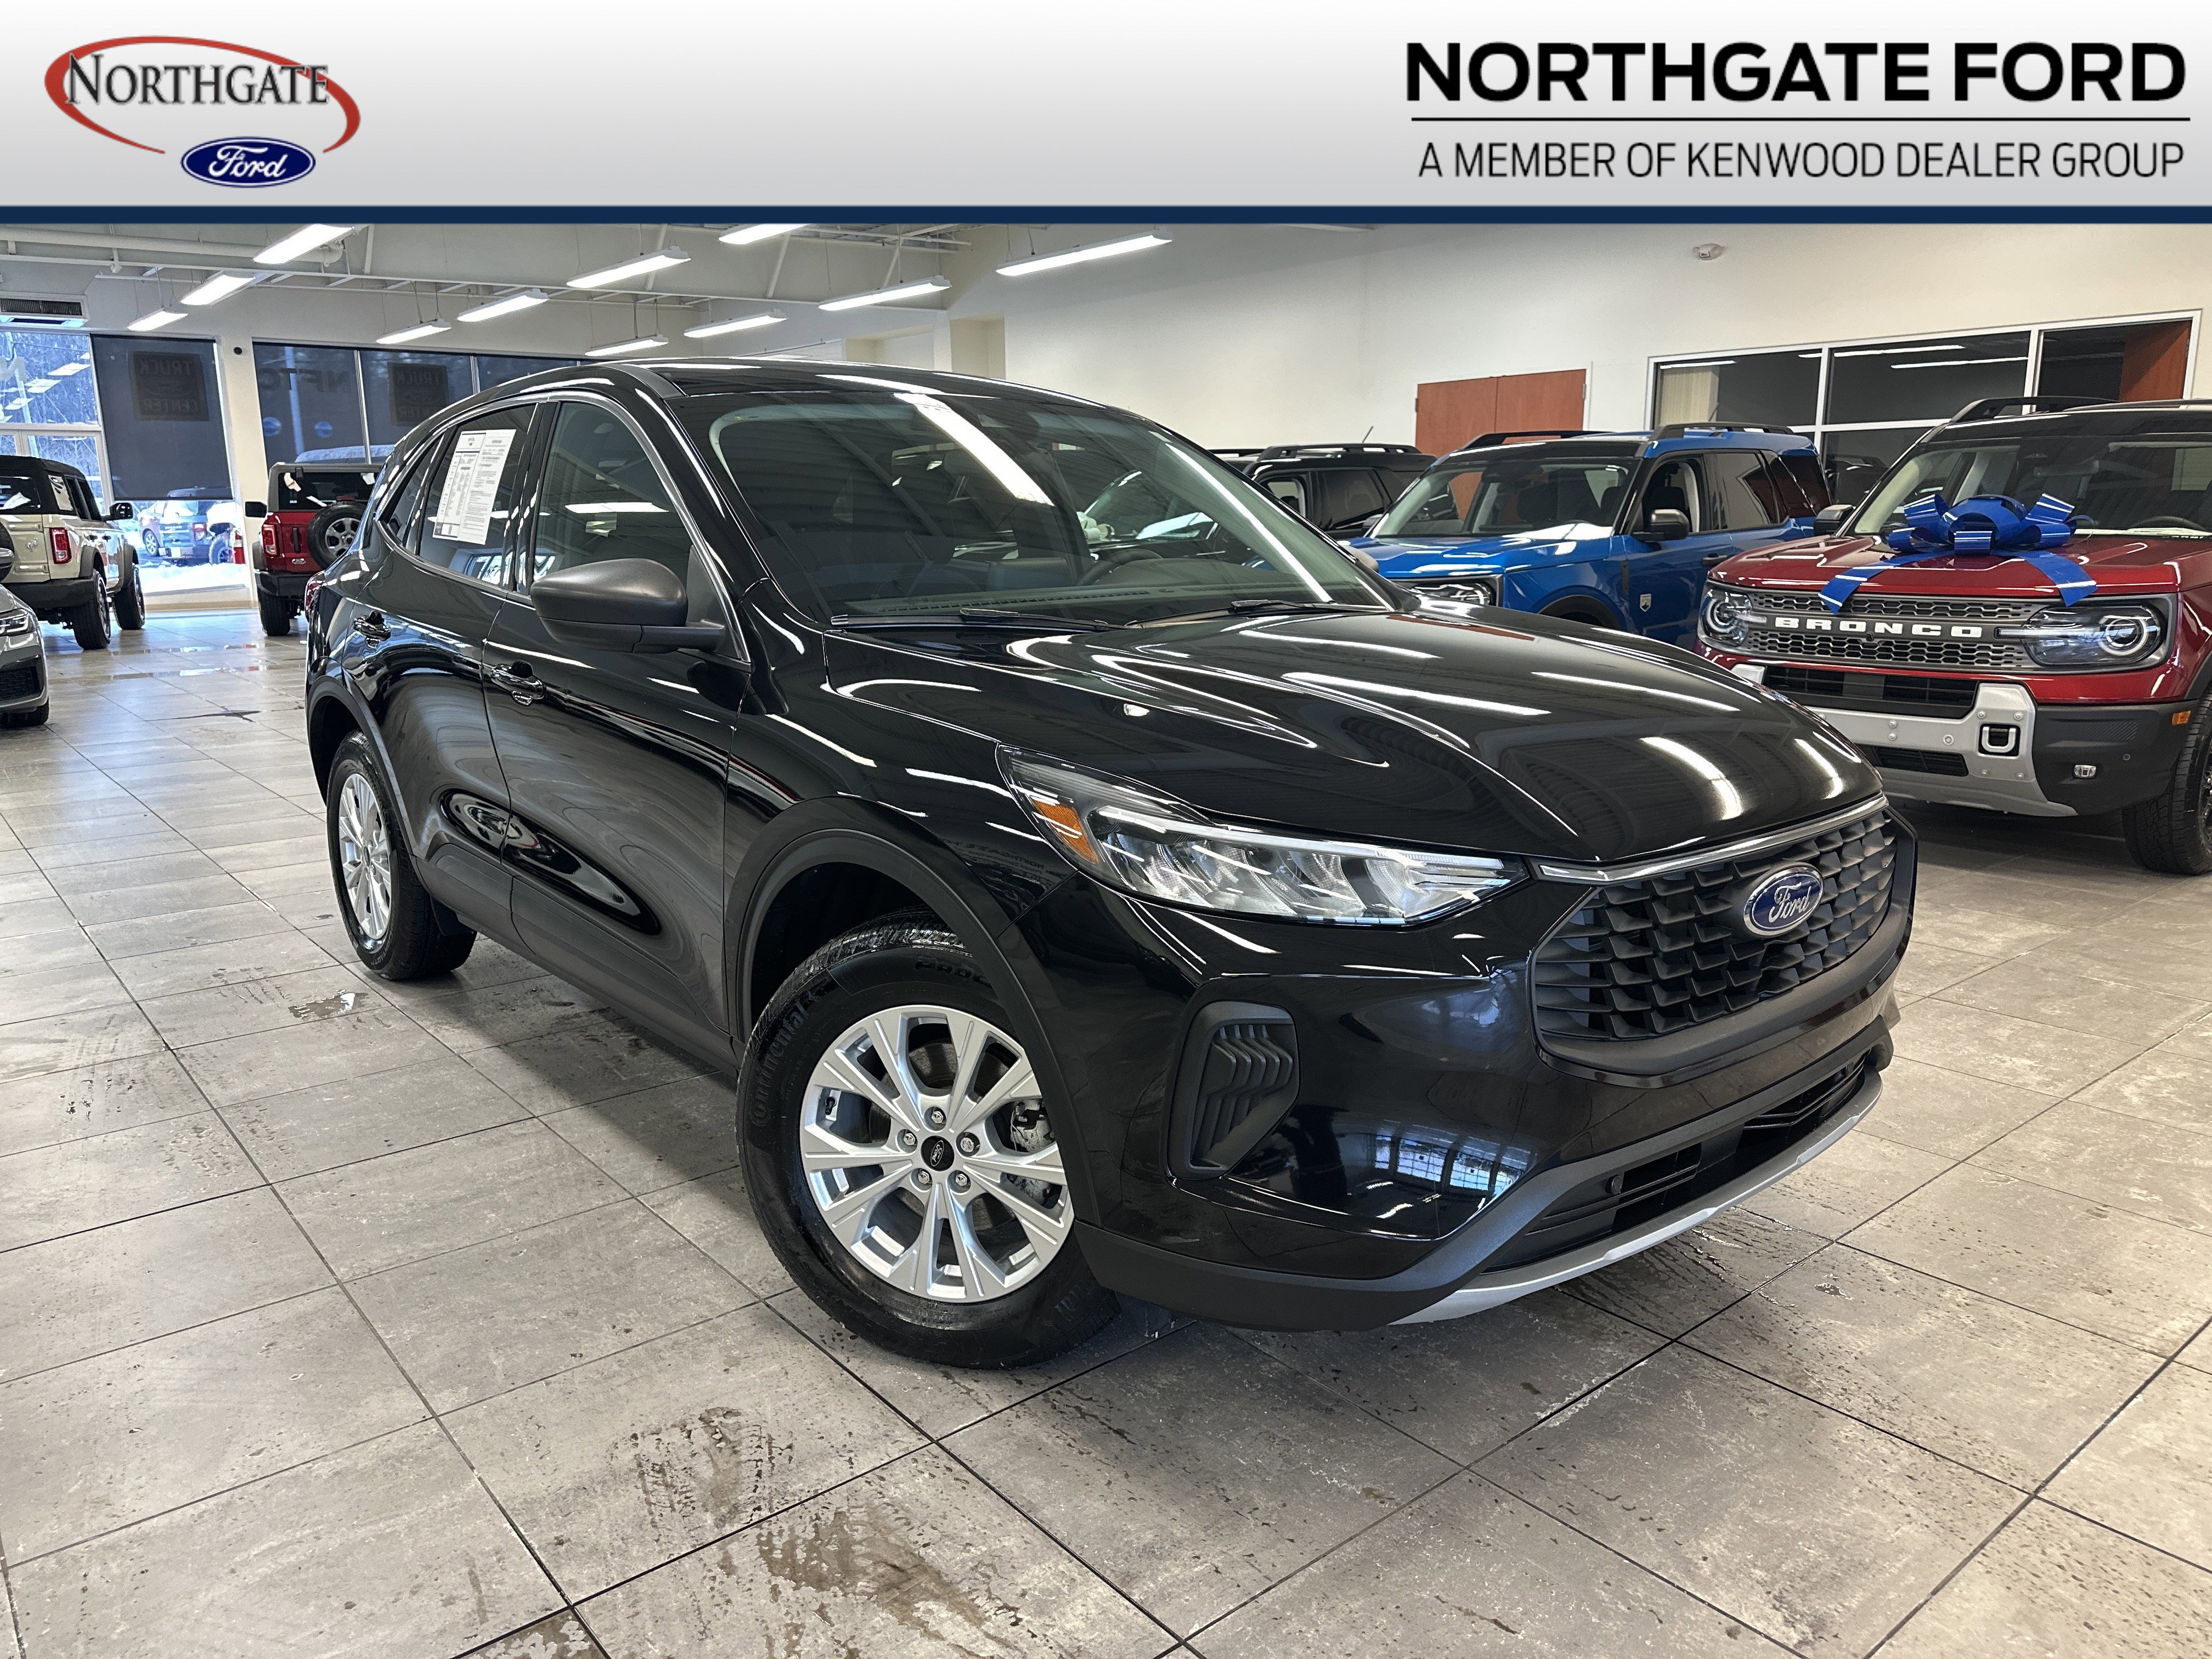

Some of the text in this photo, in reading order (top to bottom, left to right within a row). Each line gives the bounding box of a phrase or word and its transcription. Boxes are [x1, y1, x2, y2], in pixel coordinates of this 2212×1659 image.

[1774, 617, 1983, 638] BRONCO
[1768, 882, 1812, 923] Ford
[932, 1144, 943, 1163] Ford
